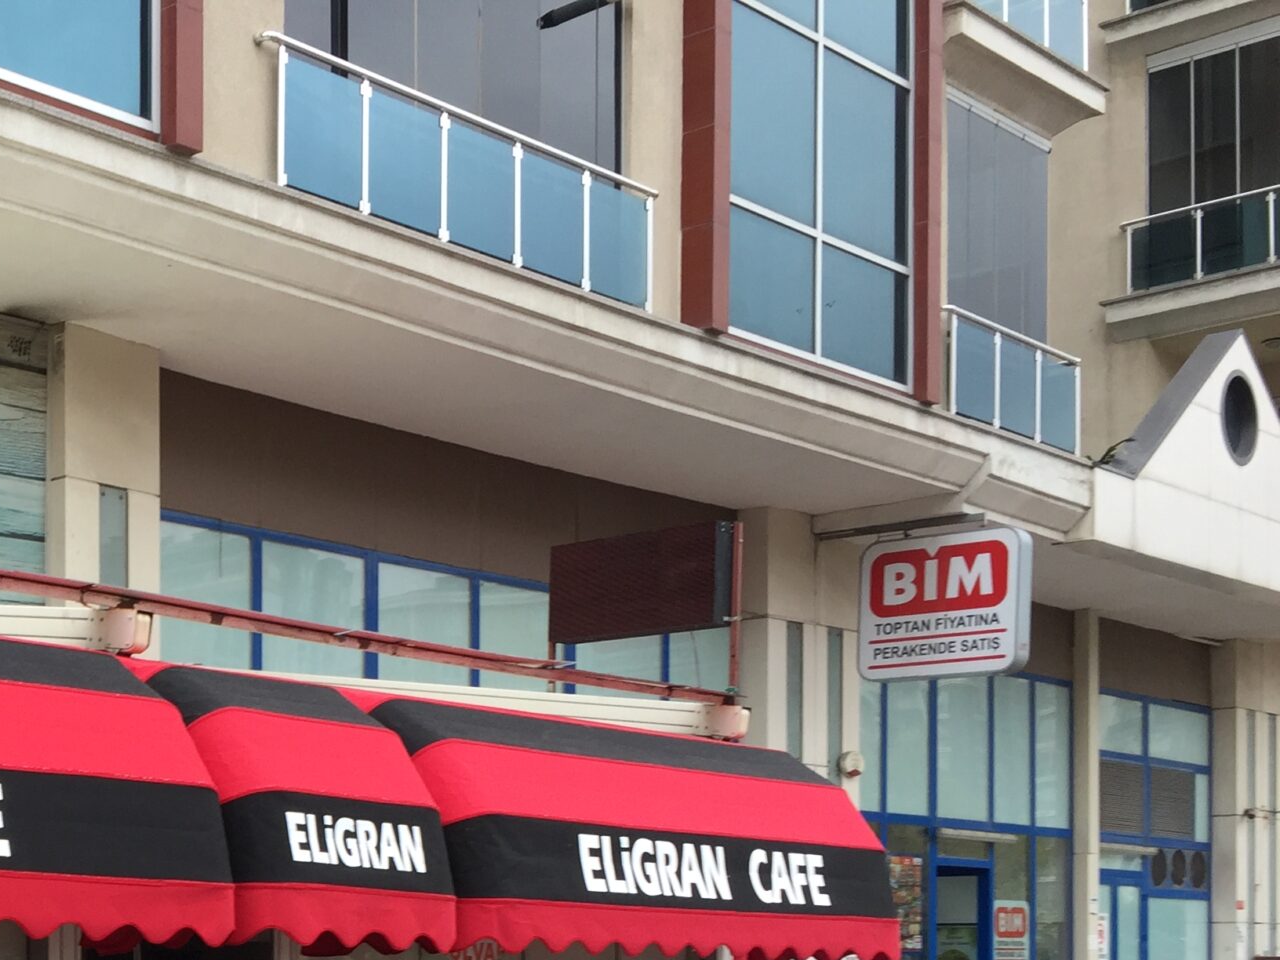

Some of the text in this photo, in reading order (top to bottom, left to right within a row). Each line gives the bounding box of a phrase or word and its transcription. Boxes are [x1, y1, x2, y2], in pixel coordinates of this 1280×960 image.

[874, 619, 931, 636] TOPTAN
[873, 641, 956, 660] PERAKENDE
[748, 848, 832, 907] CAFE
